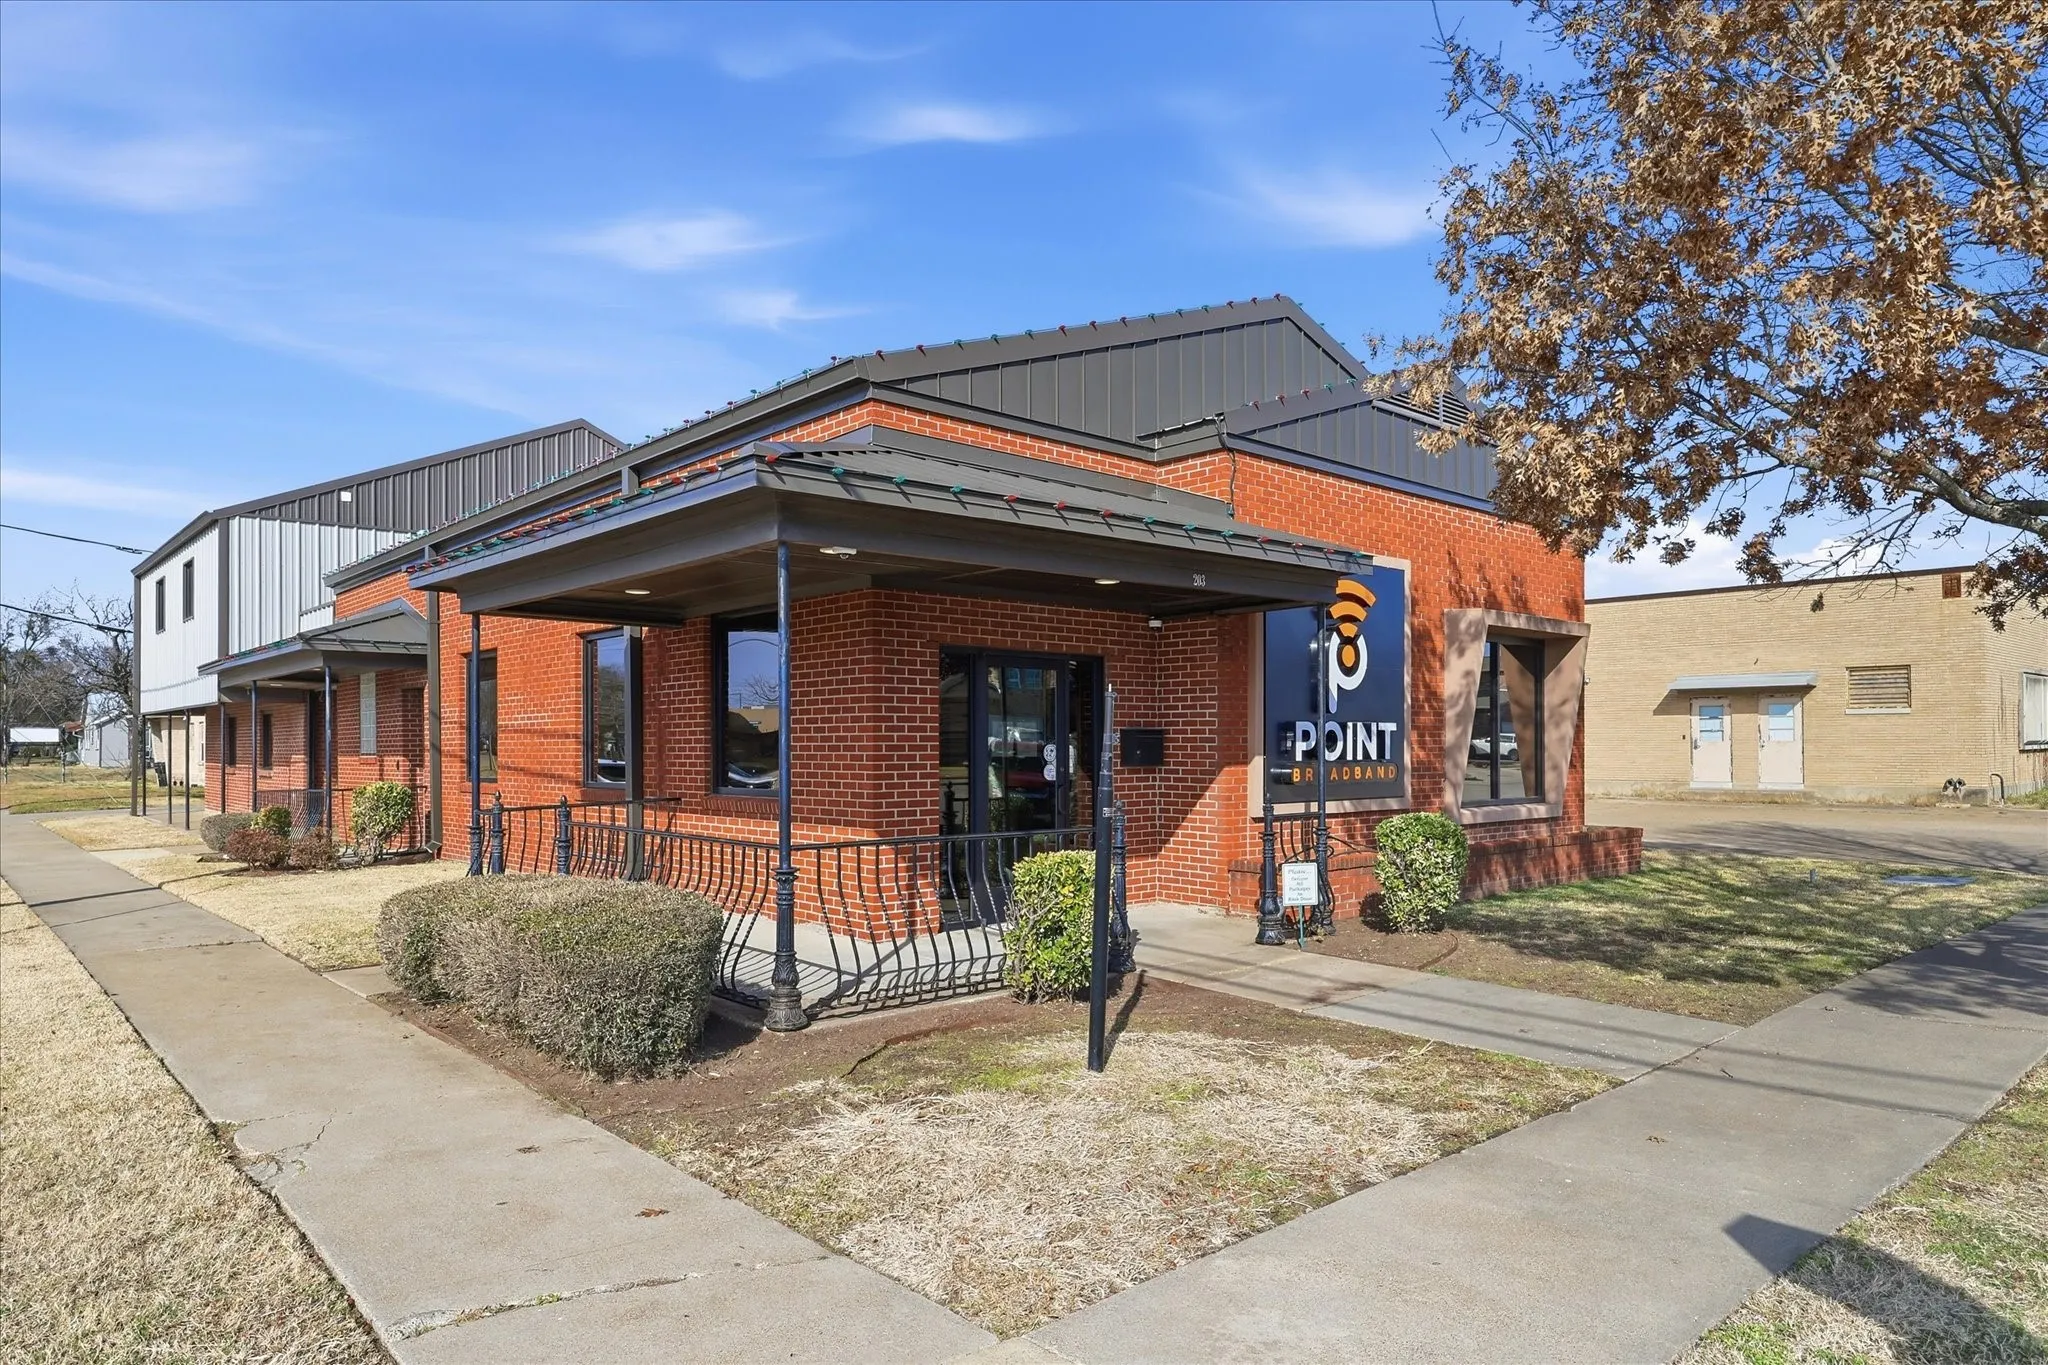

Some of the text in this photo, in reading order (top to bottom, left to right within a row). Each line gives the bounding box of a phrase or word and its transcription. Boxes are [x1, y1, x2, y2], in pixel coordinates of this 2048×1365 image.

[1193, 574, 1206, 587] 203
[1295, 720, 1397, 762] POINT
[1293, 766, 1396, 782] BRADBAND
